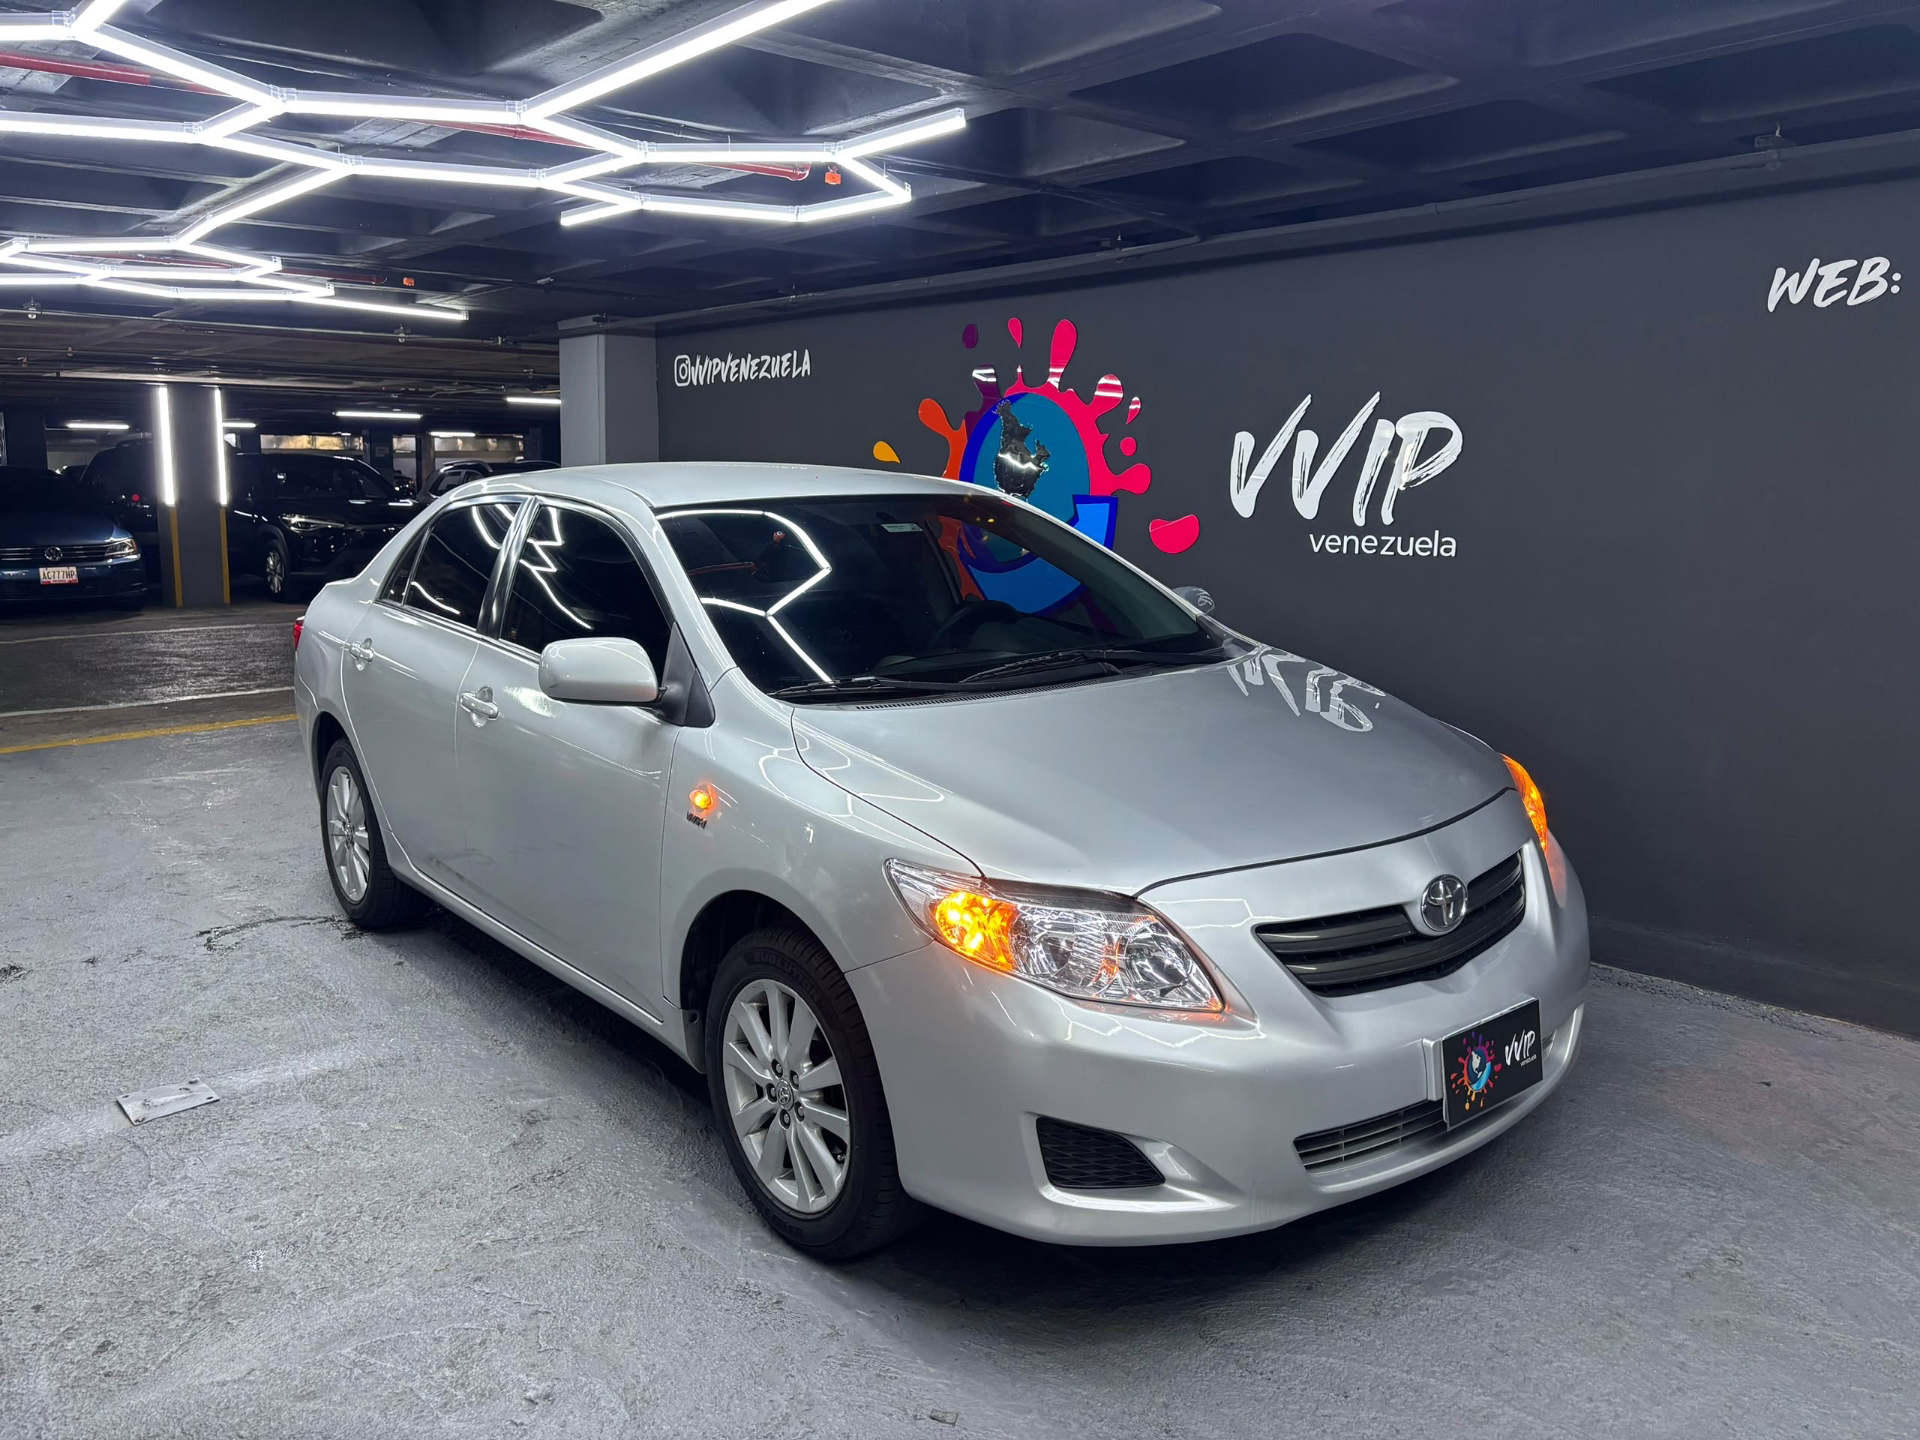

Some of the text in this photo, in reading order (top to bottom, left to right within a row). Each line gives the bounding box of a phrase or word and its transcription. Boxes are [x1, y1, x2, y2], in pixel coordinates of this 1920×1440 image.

[1767, 257, 1902, 313] WEB:
[1309, 529, 1457, 557] venezuela
[42, 570, 75, 580] AC777HP
